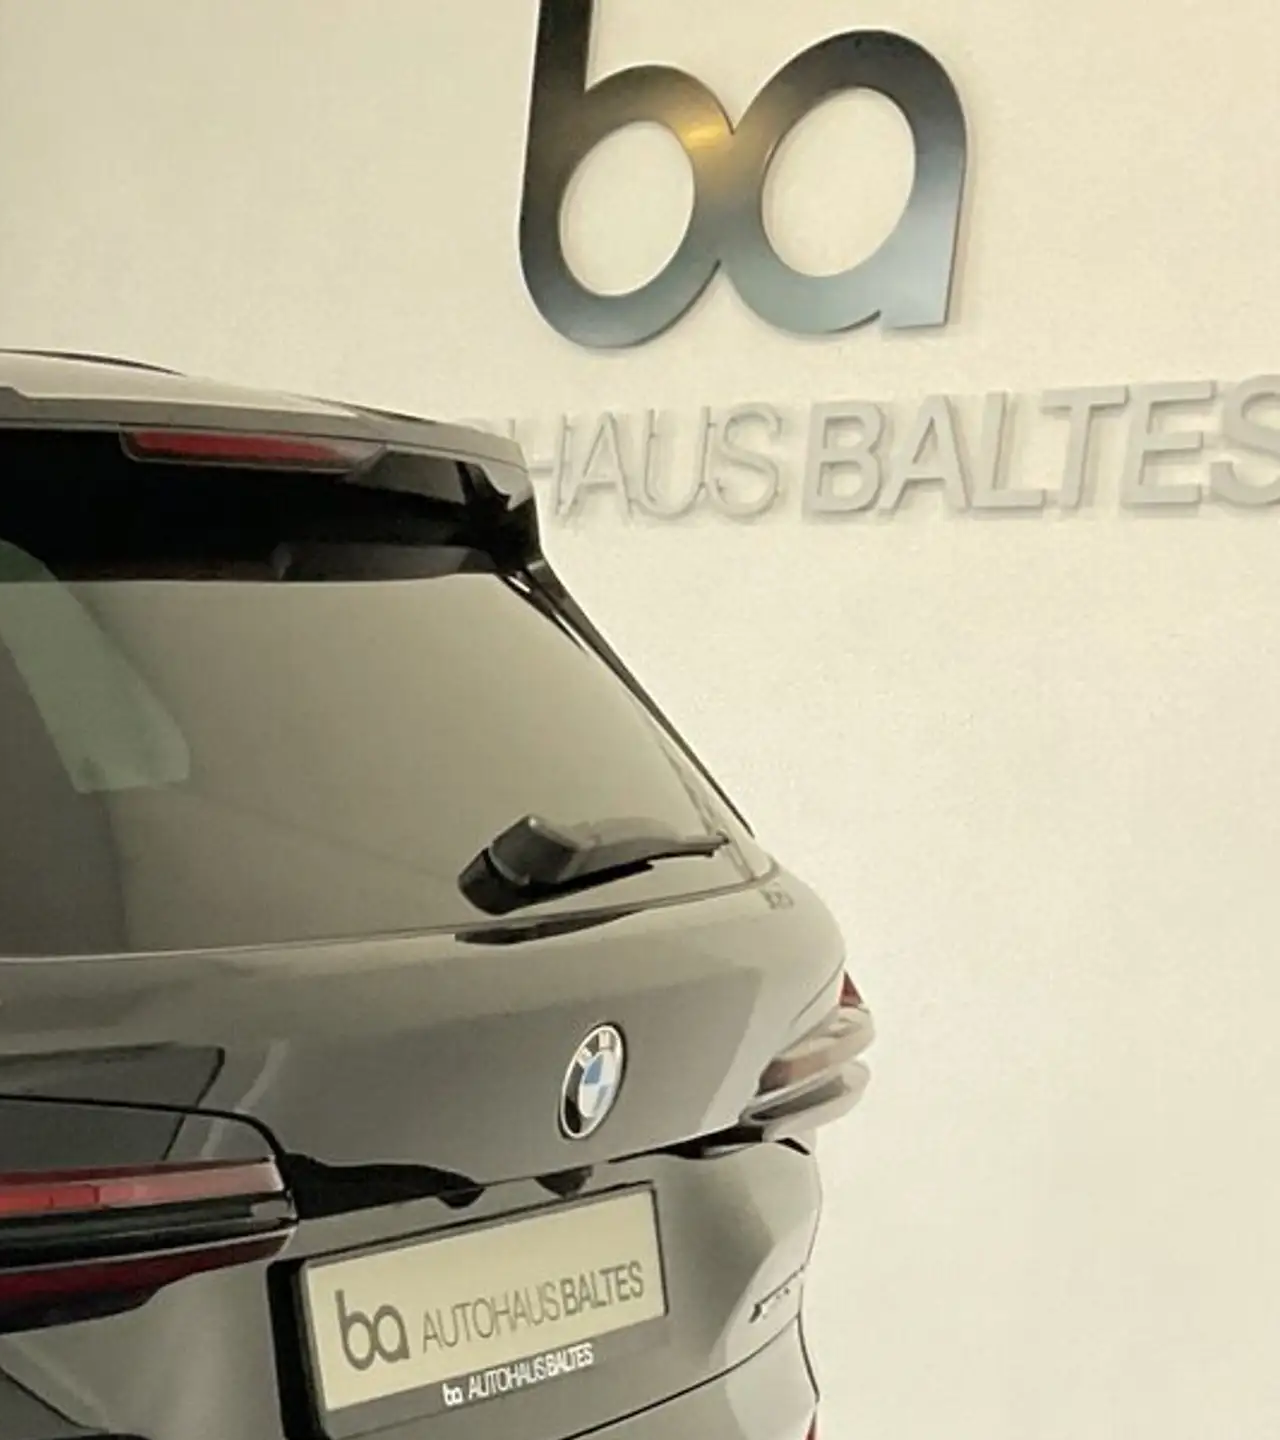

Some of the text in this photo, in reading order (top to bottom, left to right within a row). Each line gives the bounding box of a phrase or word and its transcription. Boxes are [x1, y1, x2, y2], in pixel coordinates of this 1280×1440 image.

[519, 0, 967, 348] ba
[802, 374, 1280, 518] BALTES
[334, 1260, 645, 1371] ba AUTOHAUS BALTES
[442, 1342, 594, 1407] ba AUTOHAUS BALTES
